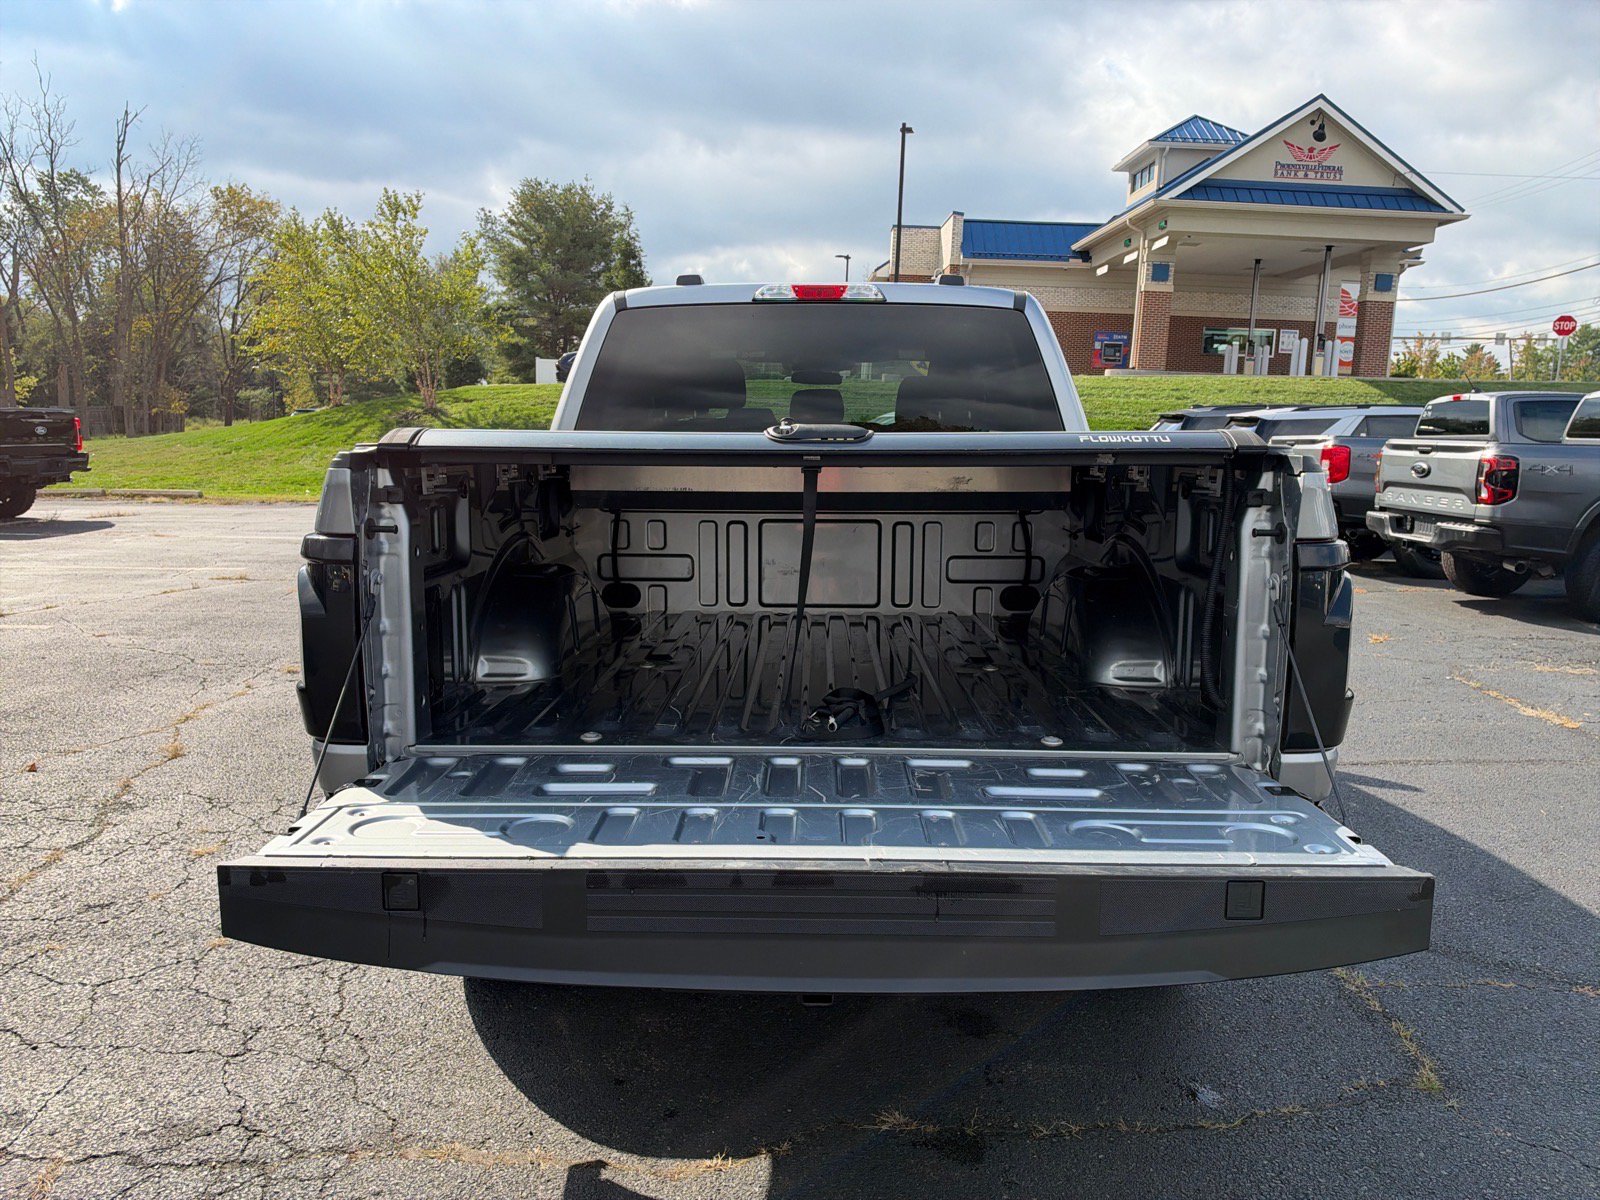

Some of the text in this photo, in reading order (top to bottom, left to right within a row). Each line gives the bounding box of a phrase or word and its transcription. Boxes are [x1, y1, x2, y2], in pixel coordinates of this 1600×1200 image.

[1314, 171, 1343, 180] TRUST
[1554, 321, 1576, 330] STOP
[1385, 491, 1465, 510] RANGER
